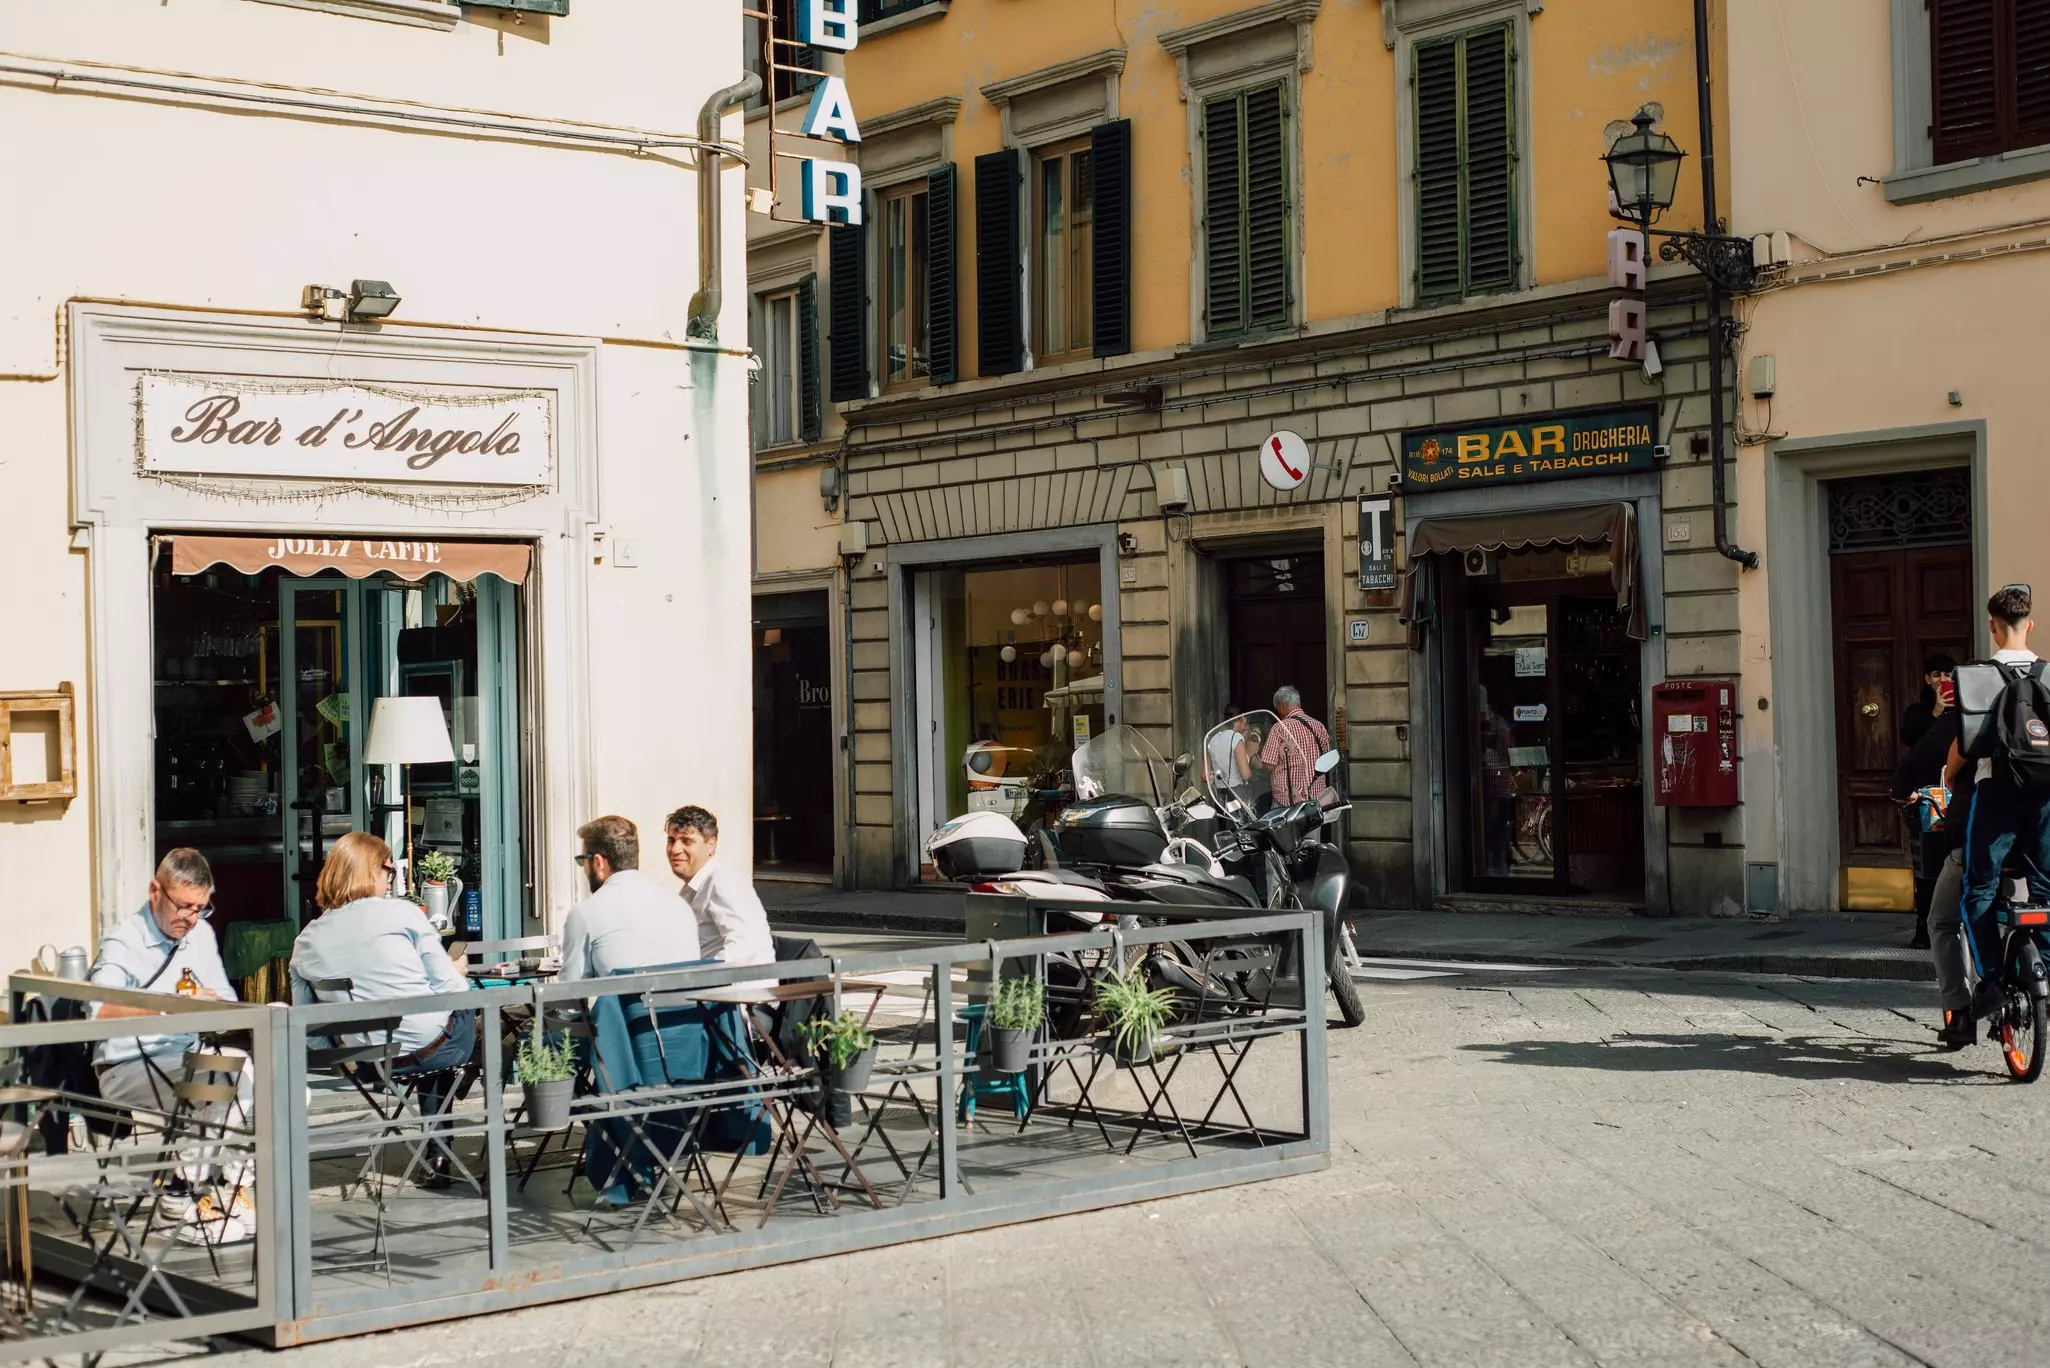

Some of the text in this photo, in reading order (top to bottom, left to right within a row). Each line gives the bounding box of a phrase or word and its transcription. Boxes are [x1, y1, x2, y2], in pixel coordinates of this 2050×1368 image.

[803, 0, 862, 225] BAR
[170, 395, 522, 471] Bar d'Angolo
[1441, 447, 1453, 455] 174
[1457, 424, 1651, 464] BAR DROGHERIA
[1407, 465, 1454, 483] VALORI BOLLATI
[1457, 451, 1629, 480] SALE E TABACCHI
[1361, 499, 1391, 561] T
[1368, 564, 1382, 572] SALI
[1361, 574, 1394, 585] TABACCHI
[1352, 622, 1368, 638] 157
[1515, 649, 1530, 659] BUS
[1664, 682, 1692, 690] POSTE
